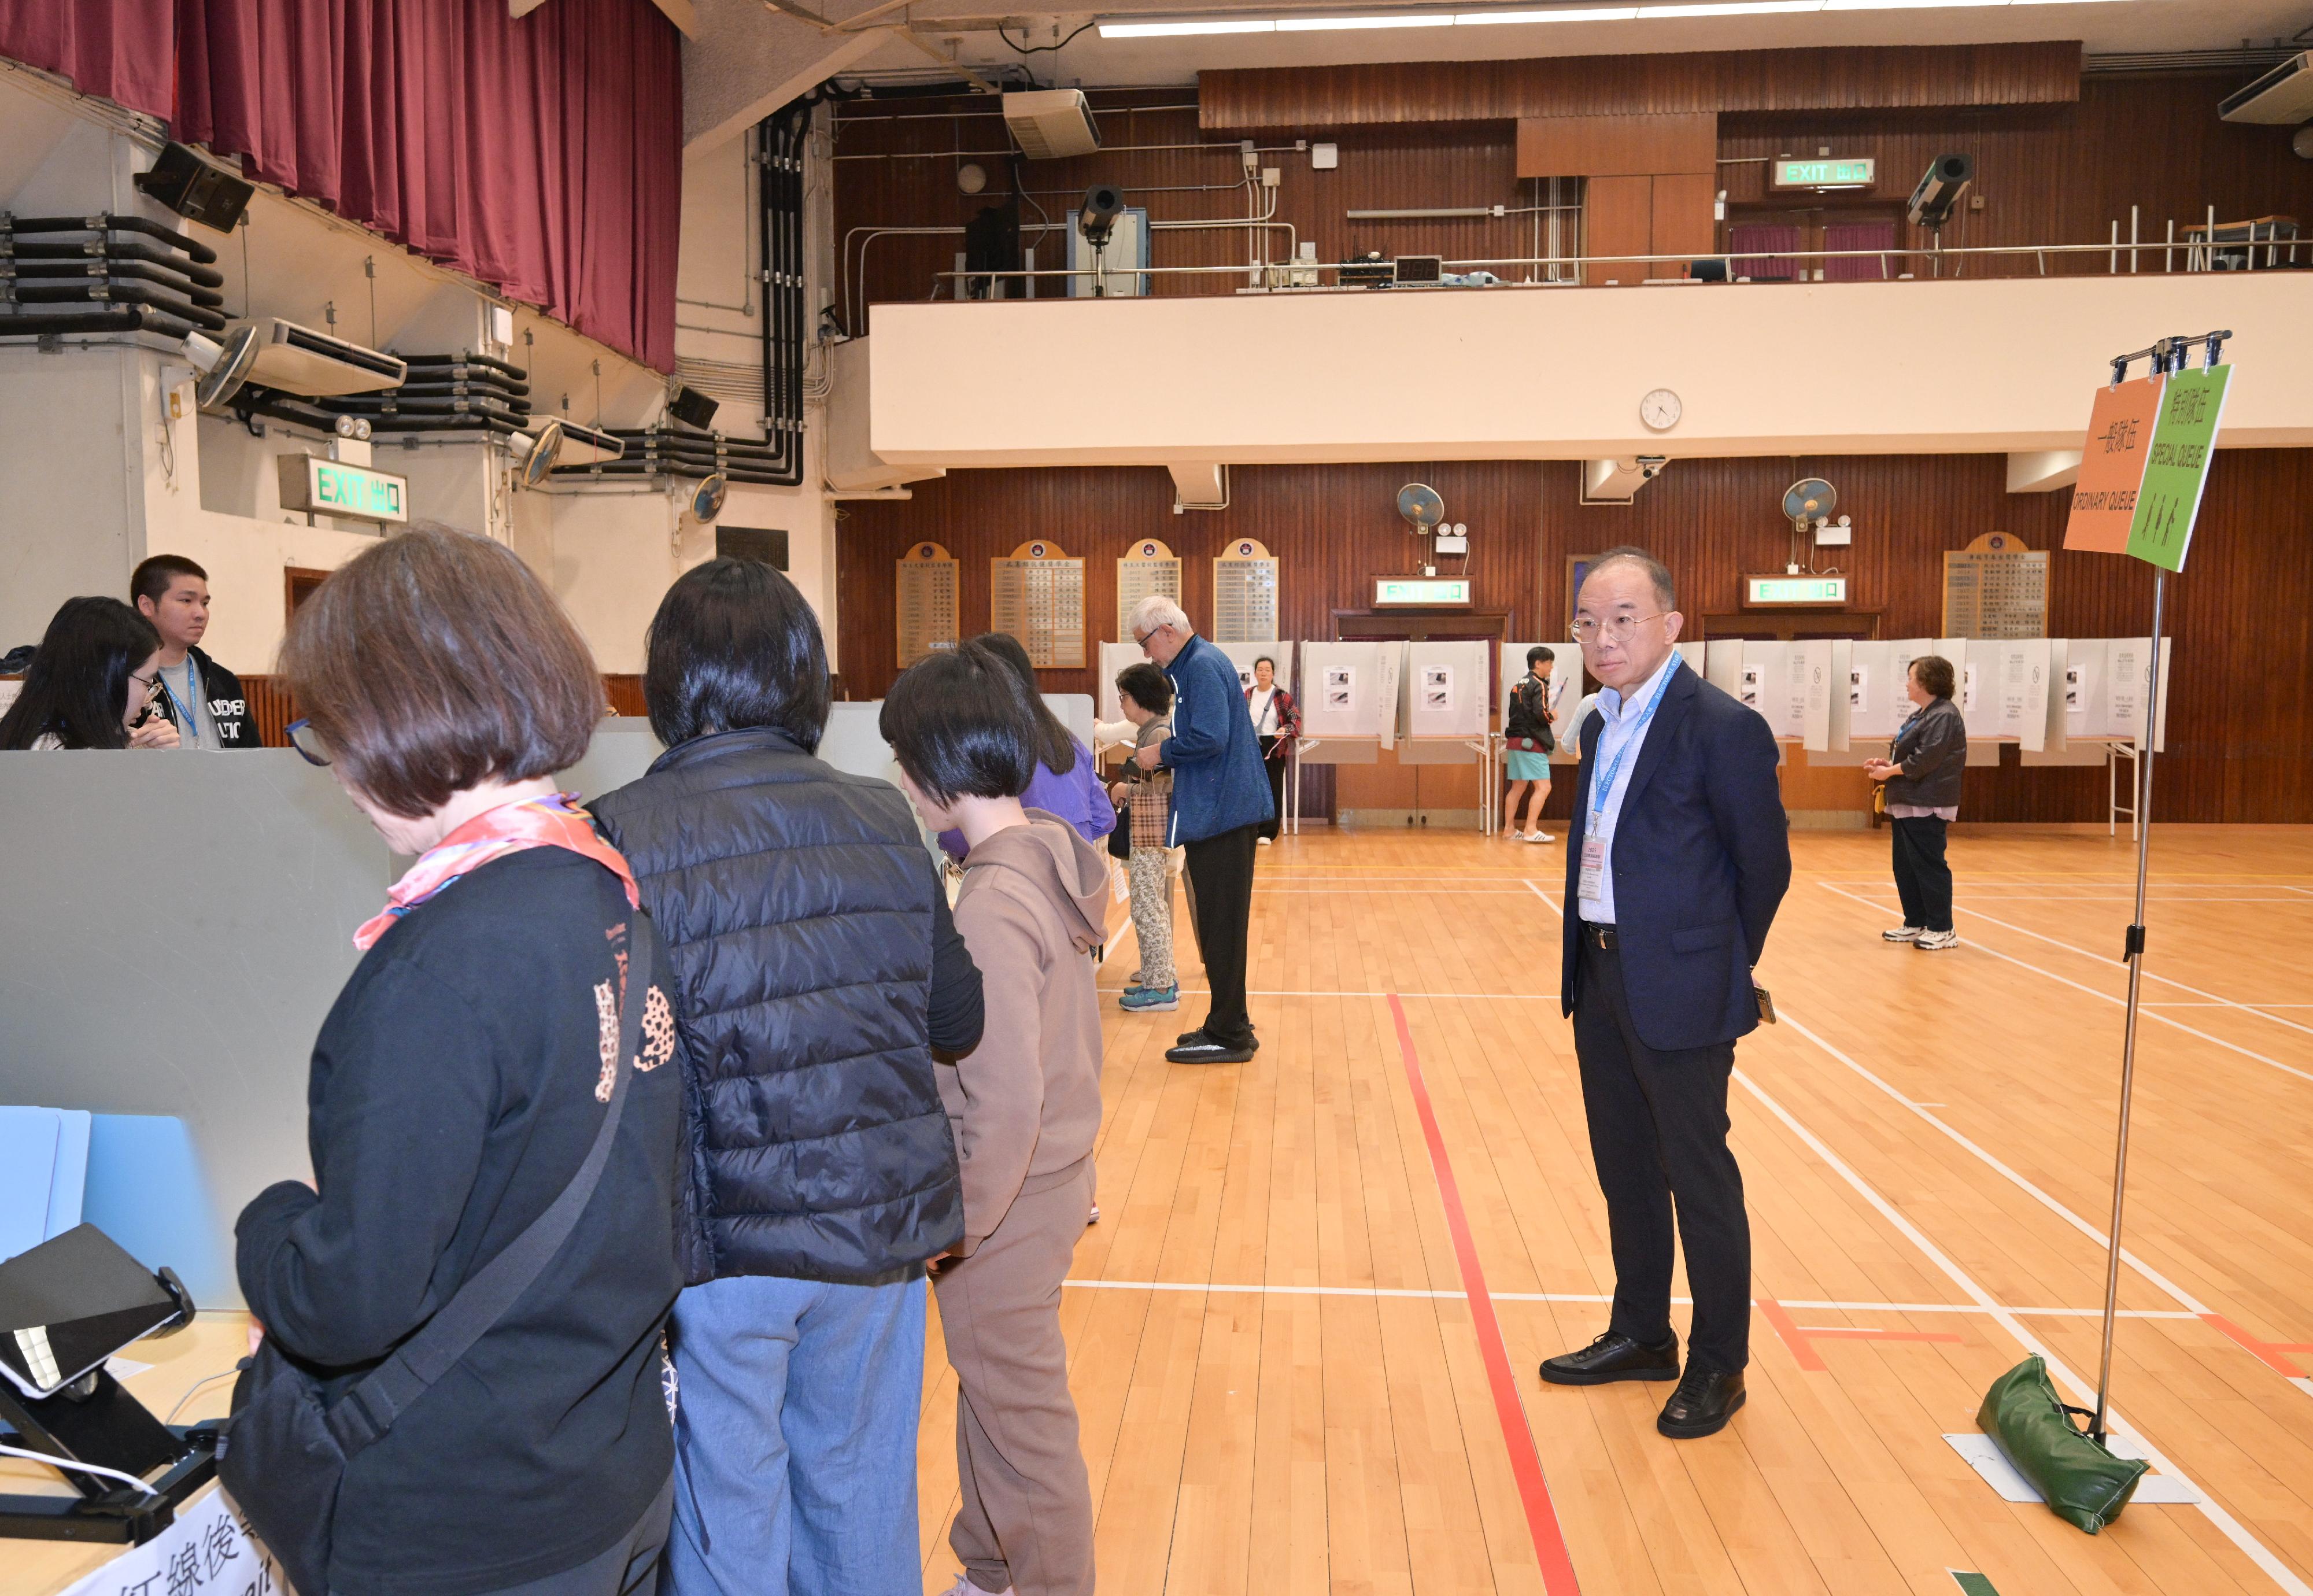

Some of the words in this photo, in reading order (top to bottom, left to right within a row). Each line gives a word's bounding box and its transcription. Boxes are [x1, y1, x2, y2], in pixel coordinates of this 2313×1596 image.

[1786, 164, 1827, 181] EXIT
[1837, 163, 1866, 180] 出口
[2169, 387, 2210, 427] 特別隊伍
[2097, 418, 2140, 455] 一般隊伍
[2151, 443, 2177, 467] SPECIAL
[2177, 444, 2204, 468] QUEUE
[317, 467, 365, 508] EXIT
[371, 480, 400, 513] 出口
[2073, 491, 2108, 511] ORDINARY
[2108, 490, 2136, 511] QUEUE
[1387, 585, 1425, 601] EXIT
[1760, 583, 1799, 598] EXIT
[1655, 667, 1674, 699] ELECTORAL
[1602, 758, 1619, 792] ELECTORAL
[239, 1553, 272, 1596] ait
